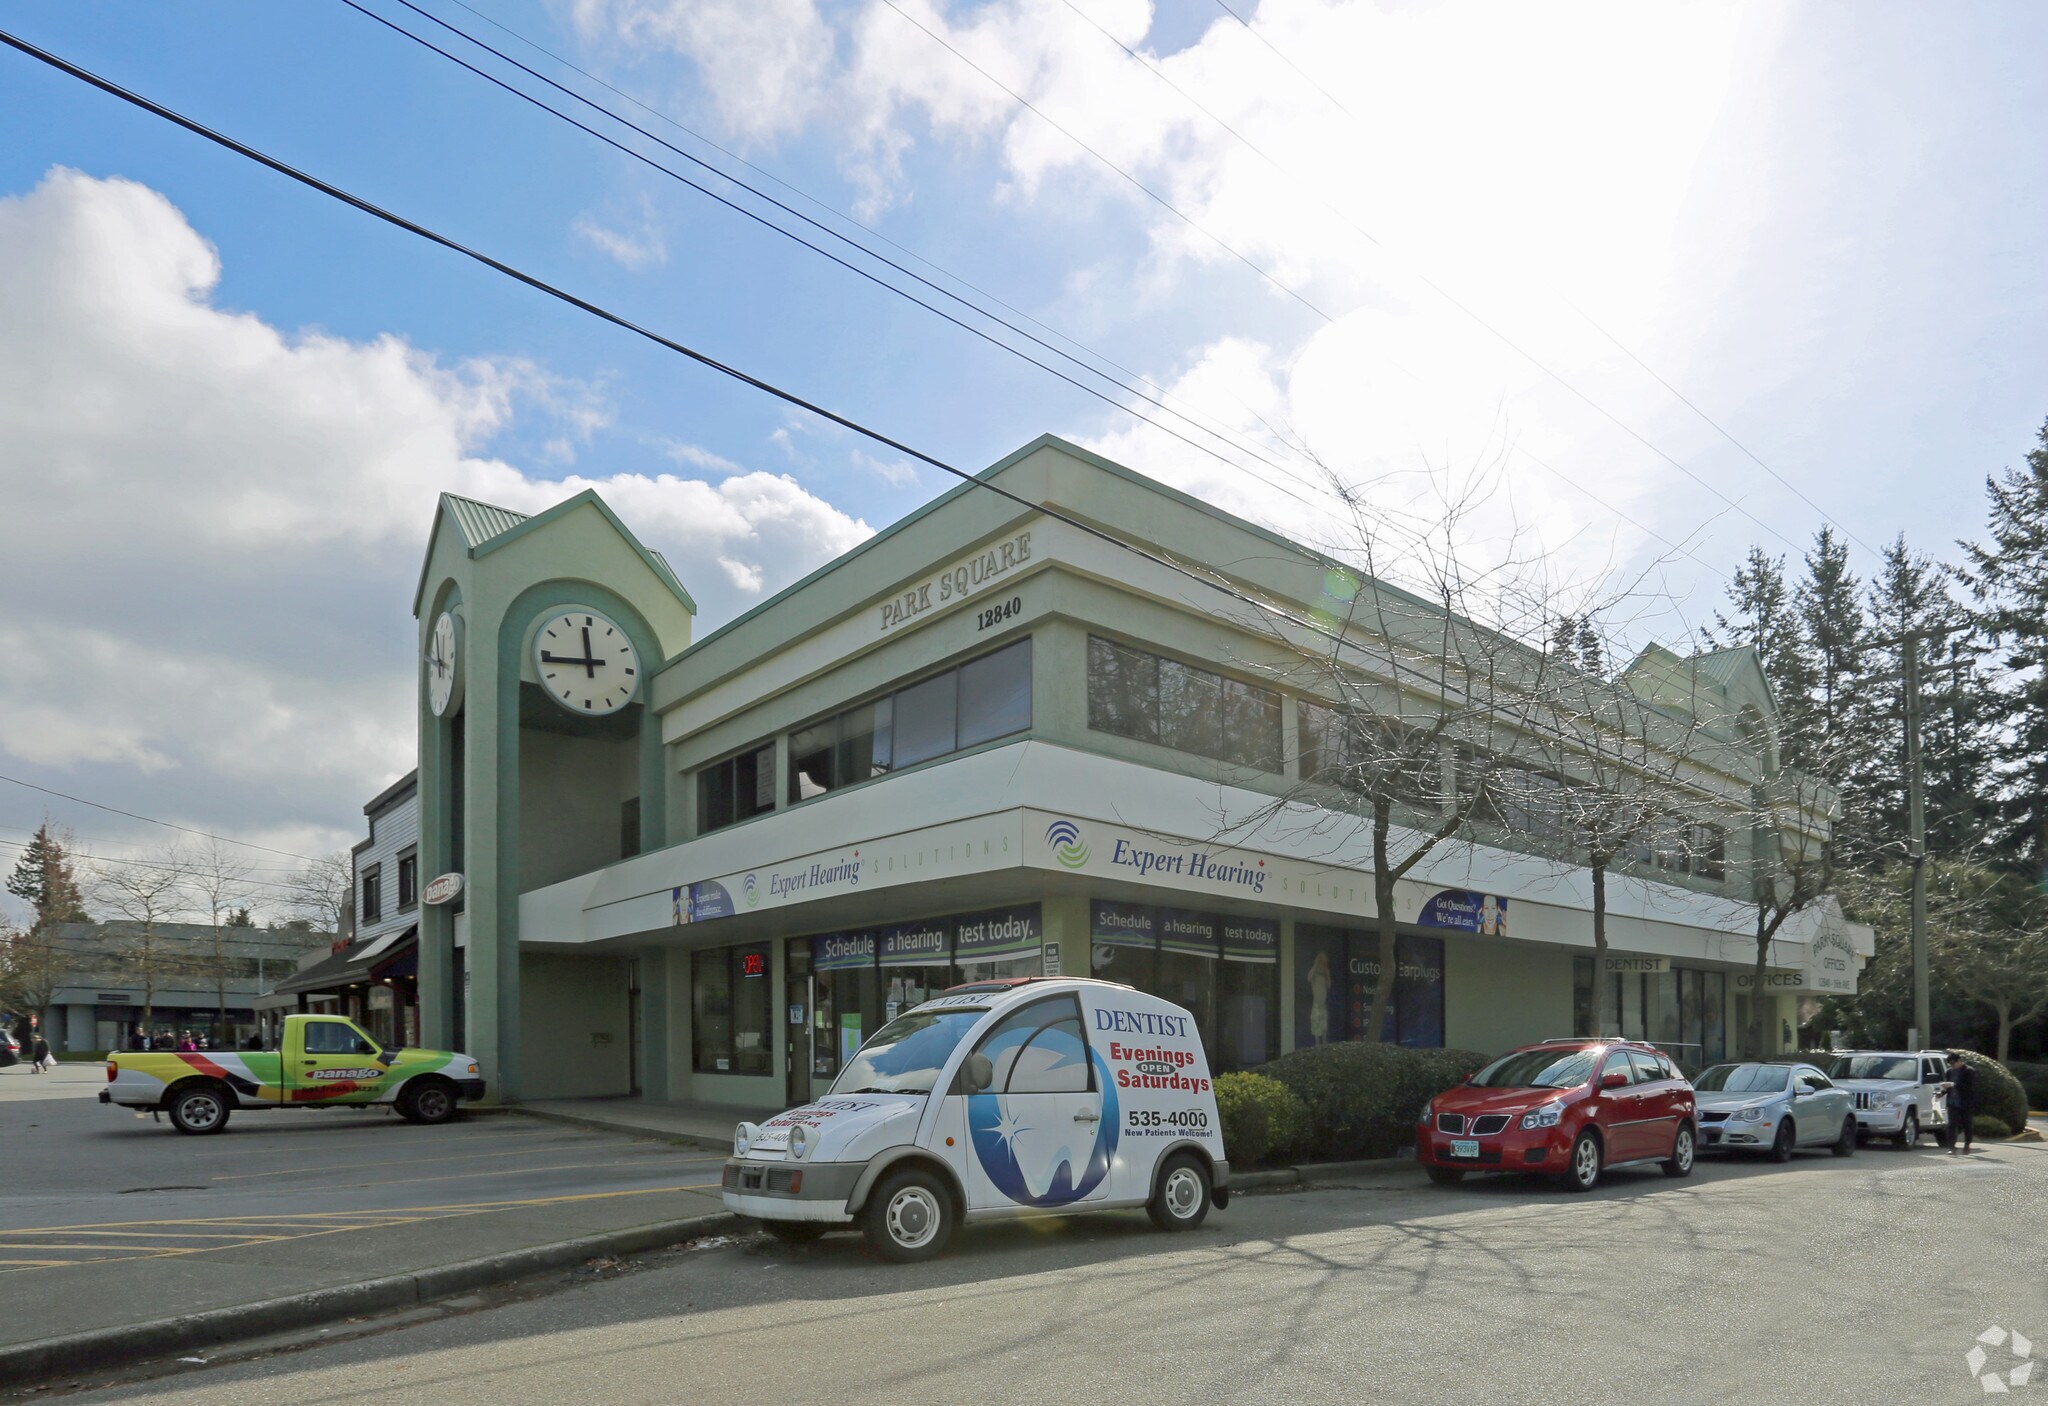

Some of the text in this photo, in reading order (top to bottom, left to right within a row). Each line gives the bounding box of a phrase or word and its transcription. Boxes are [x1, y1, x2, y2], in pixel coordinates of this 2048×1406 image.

[880, 531, 1032, 631] PARK SQUARE
[977, 596, 1022, 631] 12840
[769, 836, 1008, 898] Expert Hearing SOLUTIONS
[1111, 839, 1412, 910] Expert Hearing SOLUTINS
[426, 874, 461, 904] panago
[1436, 898, 1448, 909] Got
[825, 917, 1034, 959] Schedule a hearing test today.
[1099, 911, 1275, 945] Schedule a hearing test today.
[1350, 958, 1441, 982] Custo Earplugs
[1605, 958, 1662, 971] DENTIST
[1094, 1009, 1187, 1037] DENTIST
[1110, 1042, 1195, 1068] Evenings
[312, 1068, 380, 1080] panago
[1117, 1069, 1209, 1094] Saturdays
[1141, 1064, 1170, 1073] OPEN
[1129, 1110, 1208, 1127] 535-4000
[1145, 1129, 1176, 1137] Patients
[1178, 1129, 1213, 1138] Welcome!
